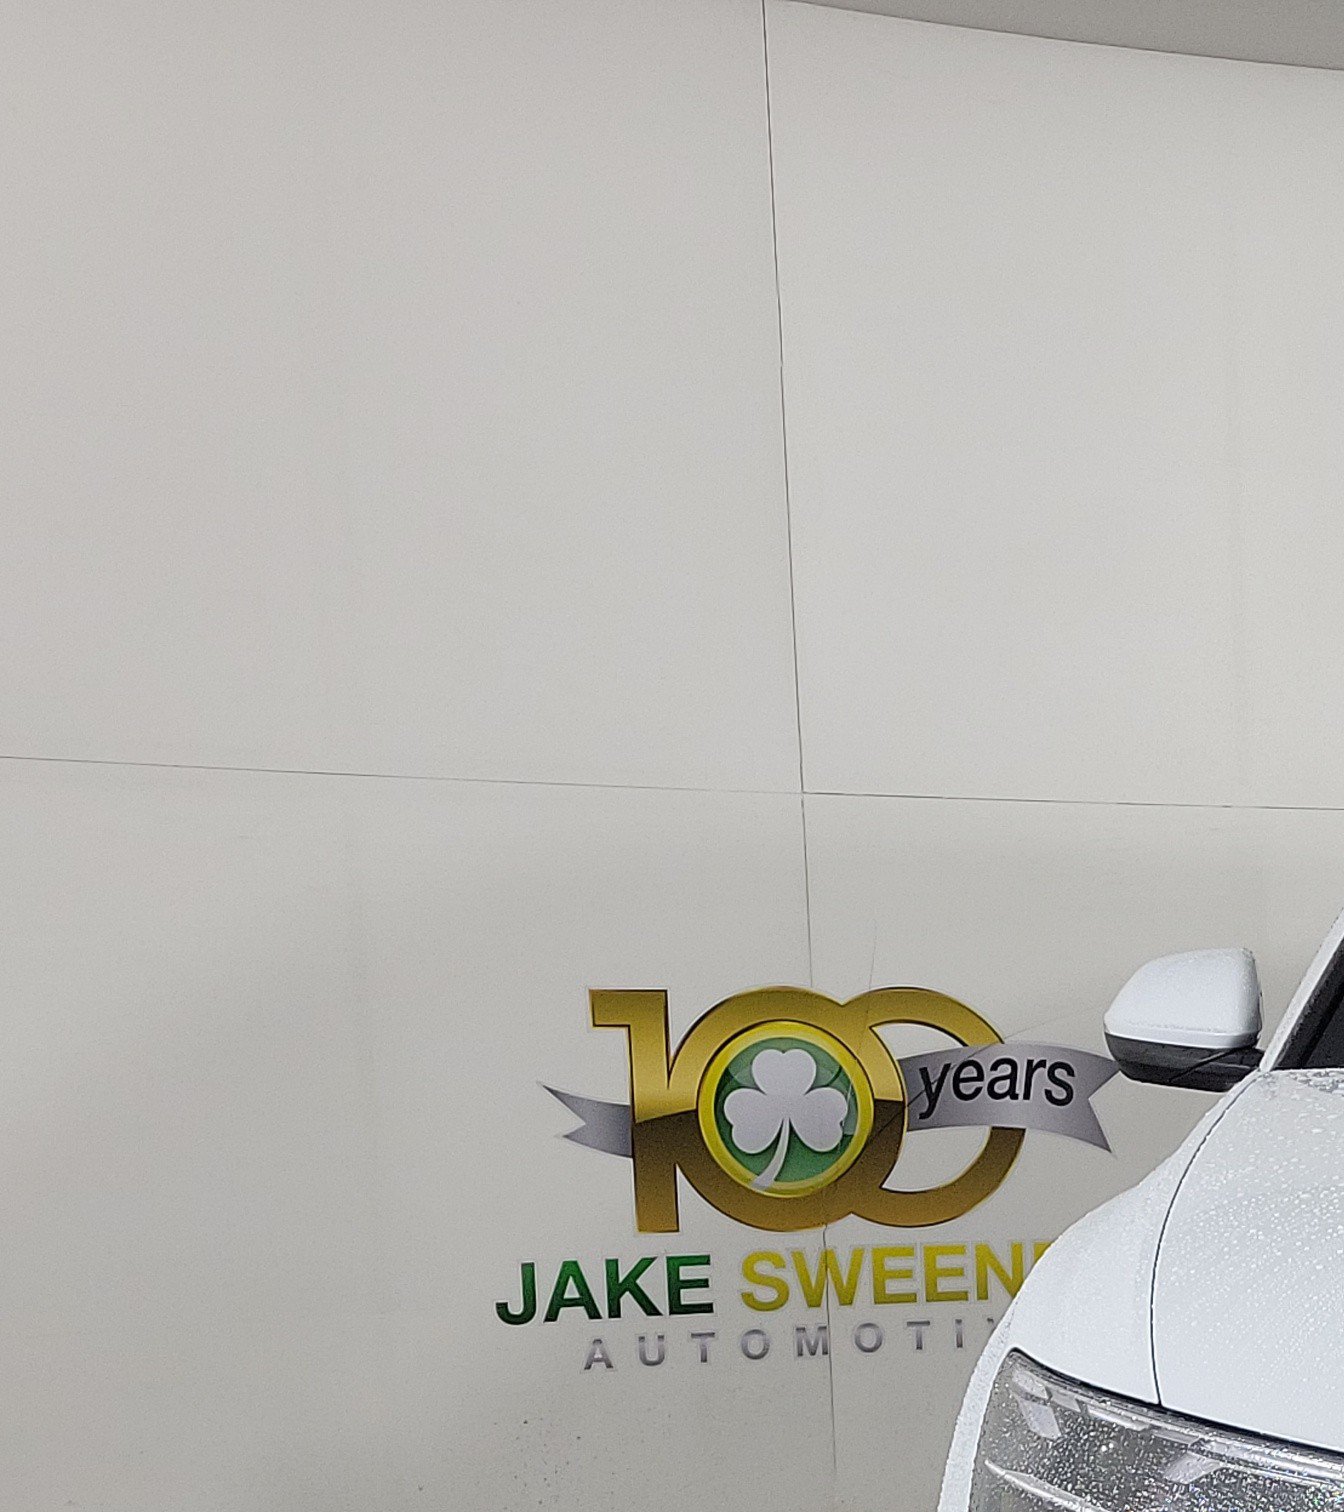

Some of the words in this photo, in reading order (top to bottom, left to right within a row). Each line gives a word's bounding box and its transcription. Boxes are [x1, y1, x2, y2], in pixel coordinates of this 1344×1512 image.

[588, 985, 1026, 1233] 100
[919, 1057, 1077, 1120] years
[495, 1254, 715, 1326] JAKE
[741, 1241, 1053, 1312] SWEEN
[583, 1317, 994, 1371] AUTOMOTI
